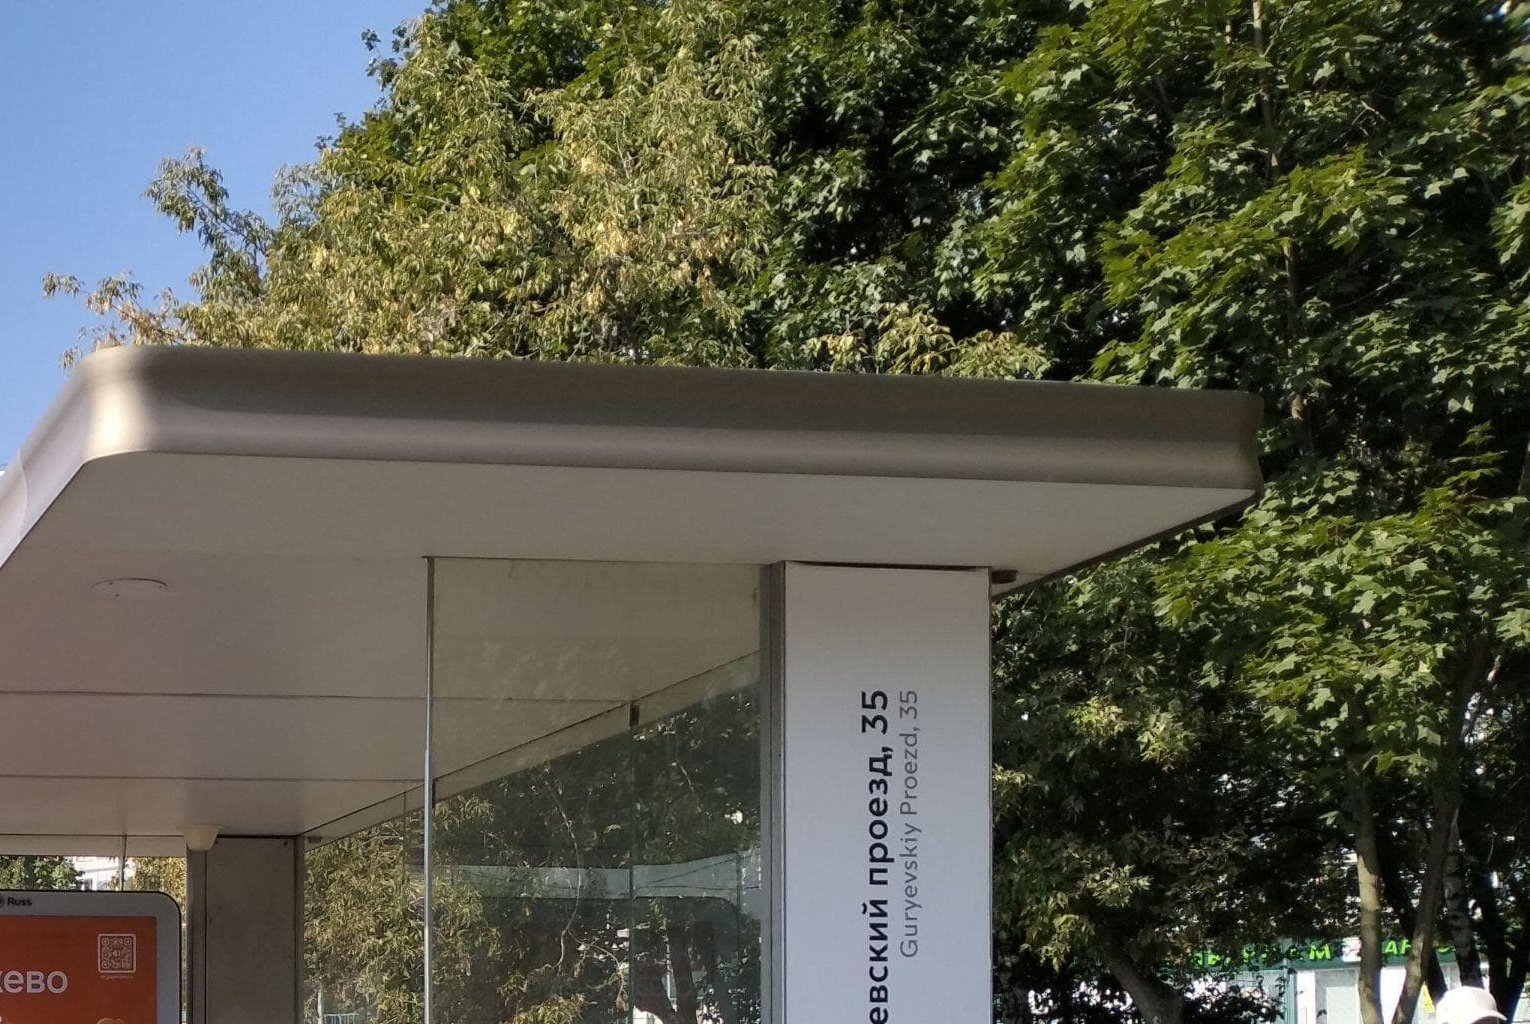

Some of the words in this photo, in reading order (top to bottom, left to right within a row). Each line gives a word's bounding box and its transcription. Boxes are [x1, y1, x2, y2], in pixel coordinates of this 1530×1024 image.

[861, 690, 889, 735] 35
[899, 690, 919, 720] 35
[898, 727, 921, 816] Proezd,
[868, 746, 895, 886] проезд,
[6, 896, 33, 907] Russ
[898, 822, 923, 958] Guryevskiy
